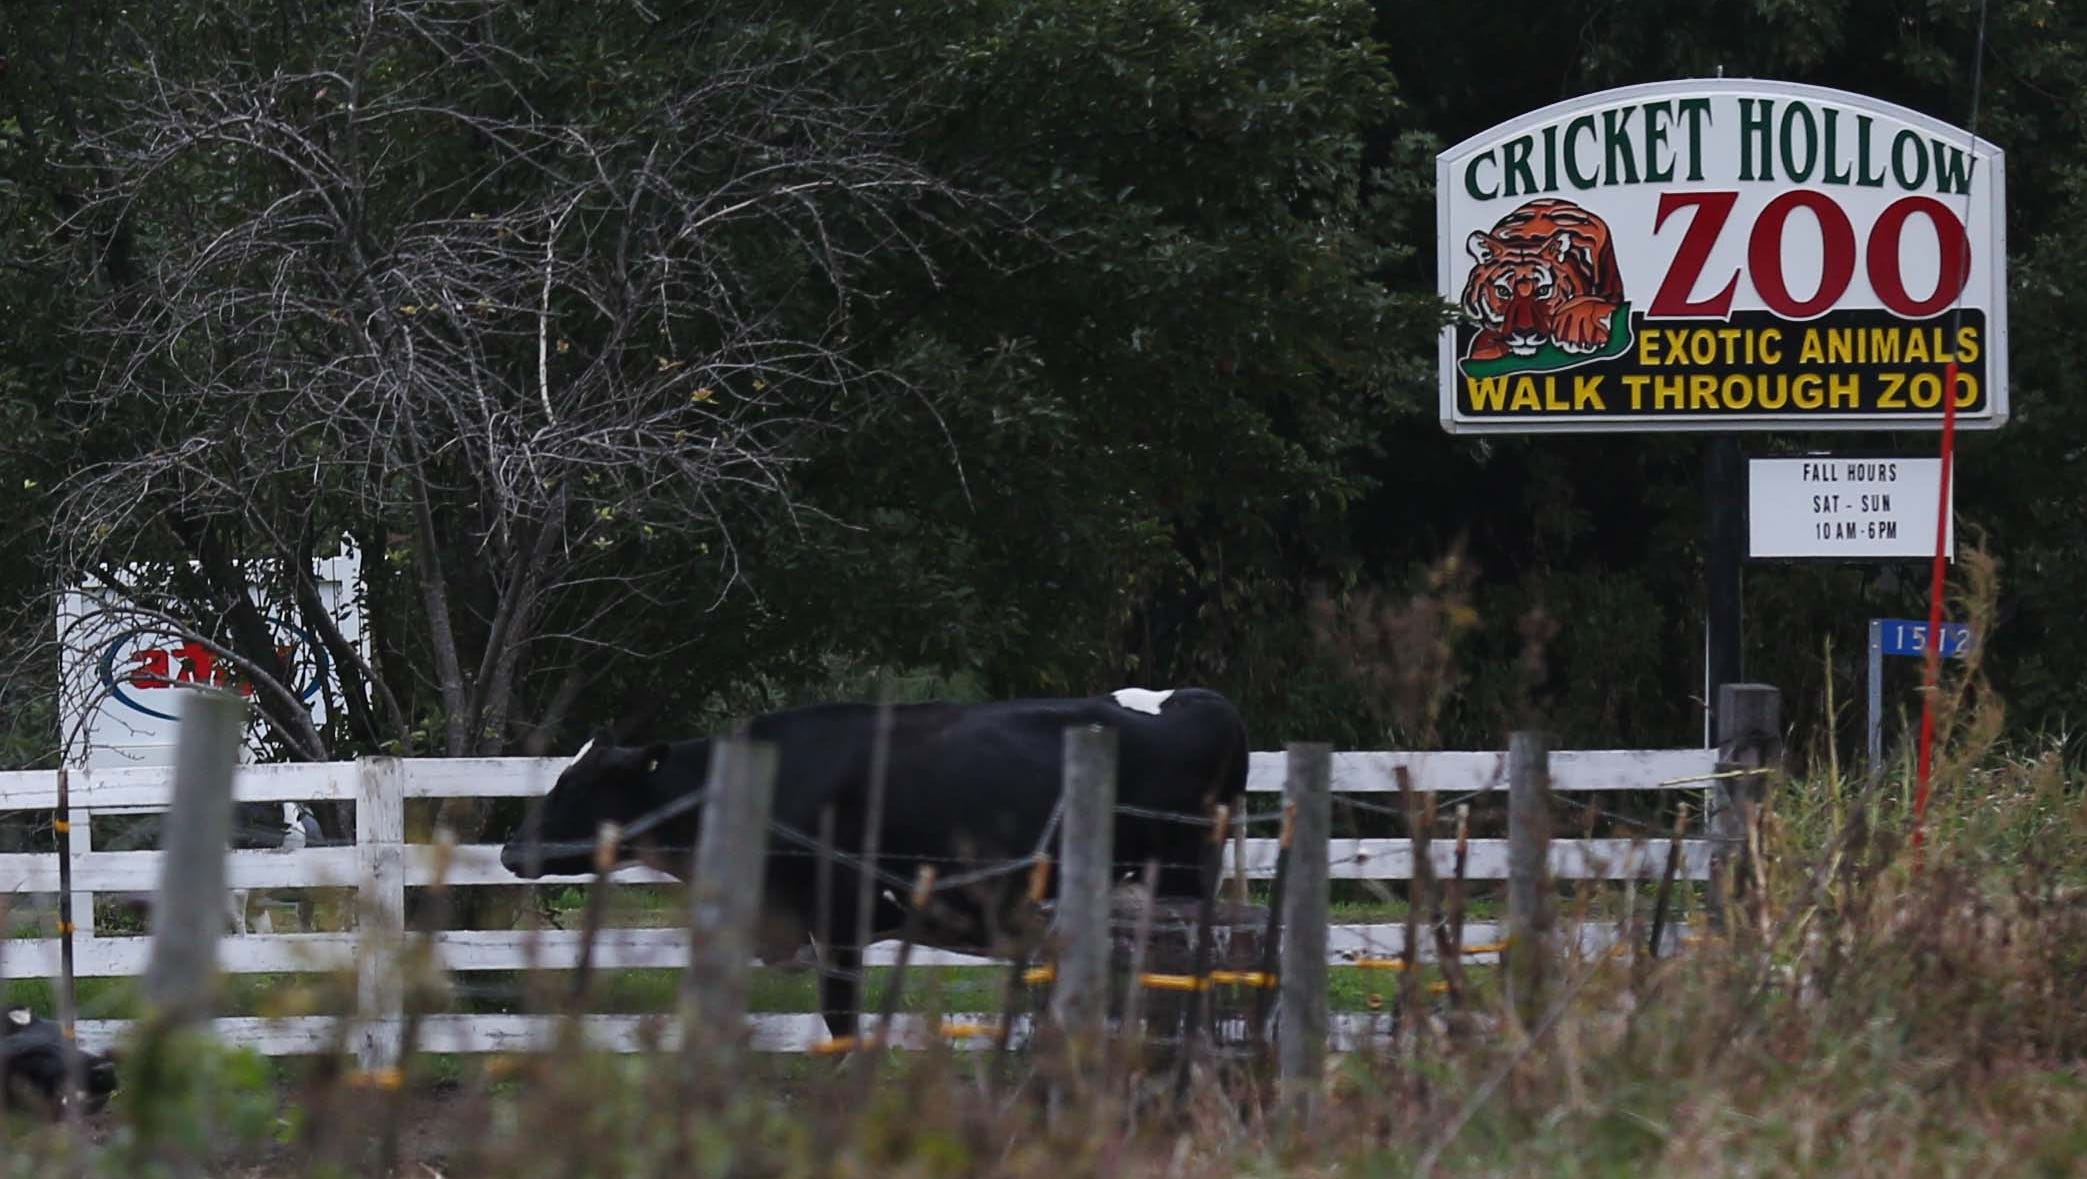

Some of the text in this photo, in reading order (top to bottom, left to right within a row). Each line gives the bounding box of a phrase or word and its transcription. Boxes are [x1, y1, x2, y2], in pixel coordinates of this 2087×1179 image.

[1464, 98, 1977, 201] CRICKET HOLLOW
[1647, 189, 1971, 318] ZOO
[1639, 326, 1980, 366] EXOTIC ANIMALS
[1466, 372, 1979, 411] WALK THROUGH ZOO
[1803, 463, 1897, 482] FALL HOURS
[1813, 495, 1840, 513] SAT
[1861, 495, 1891, 512] SUN
[1896, 625, 1970, 656] 1512
